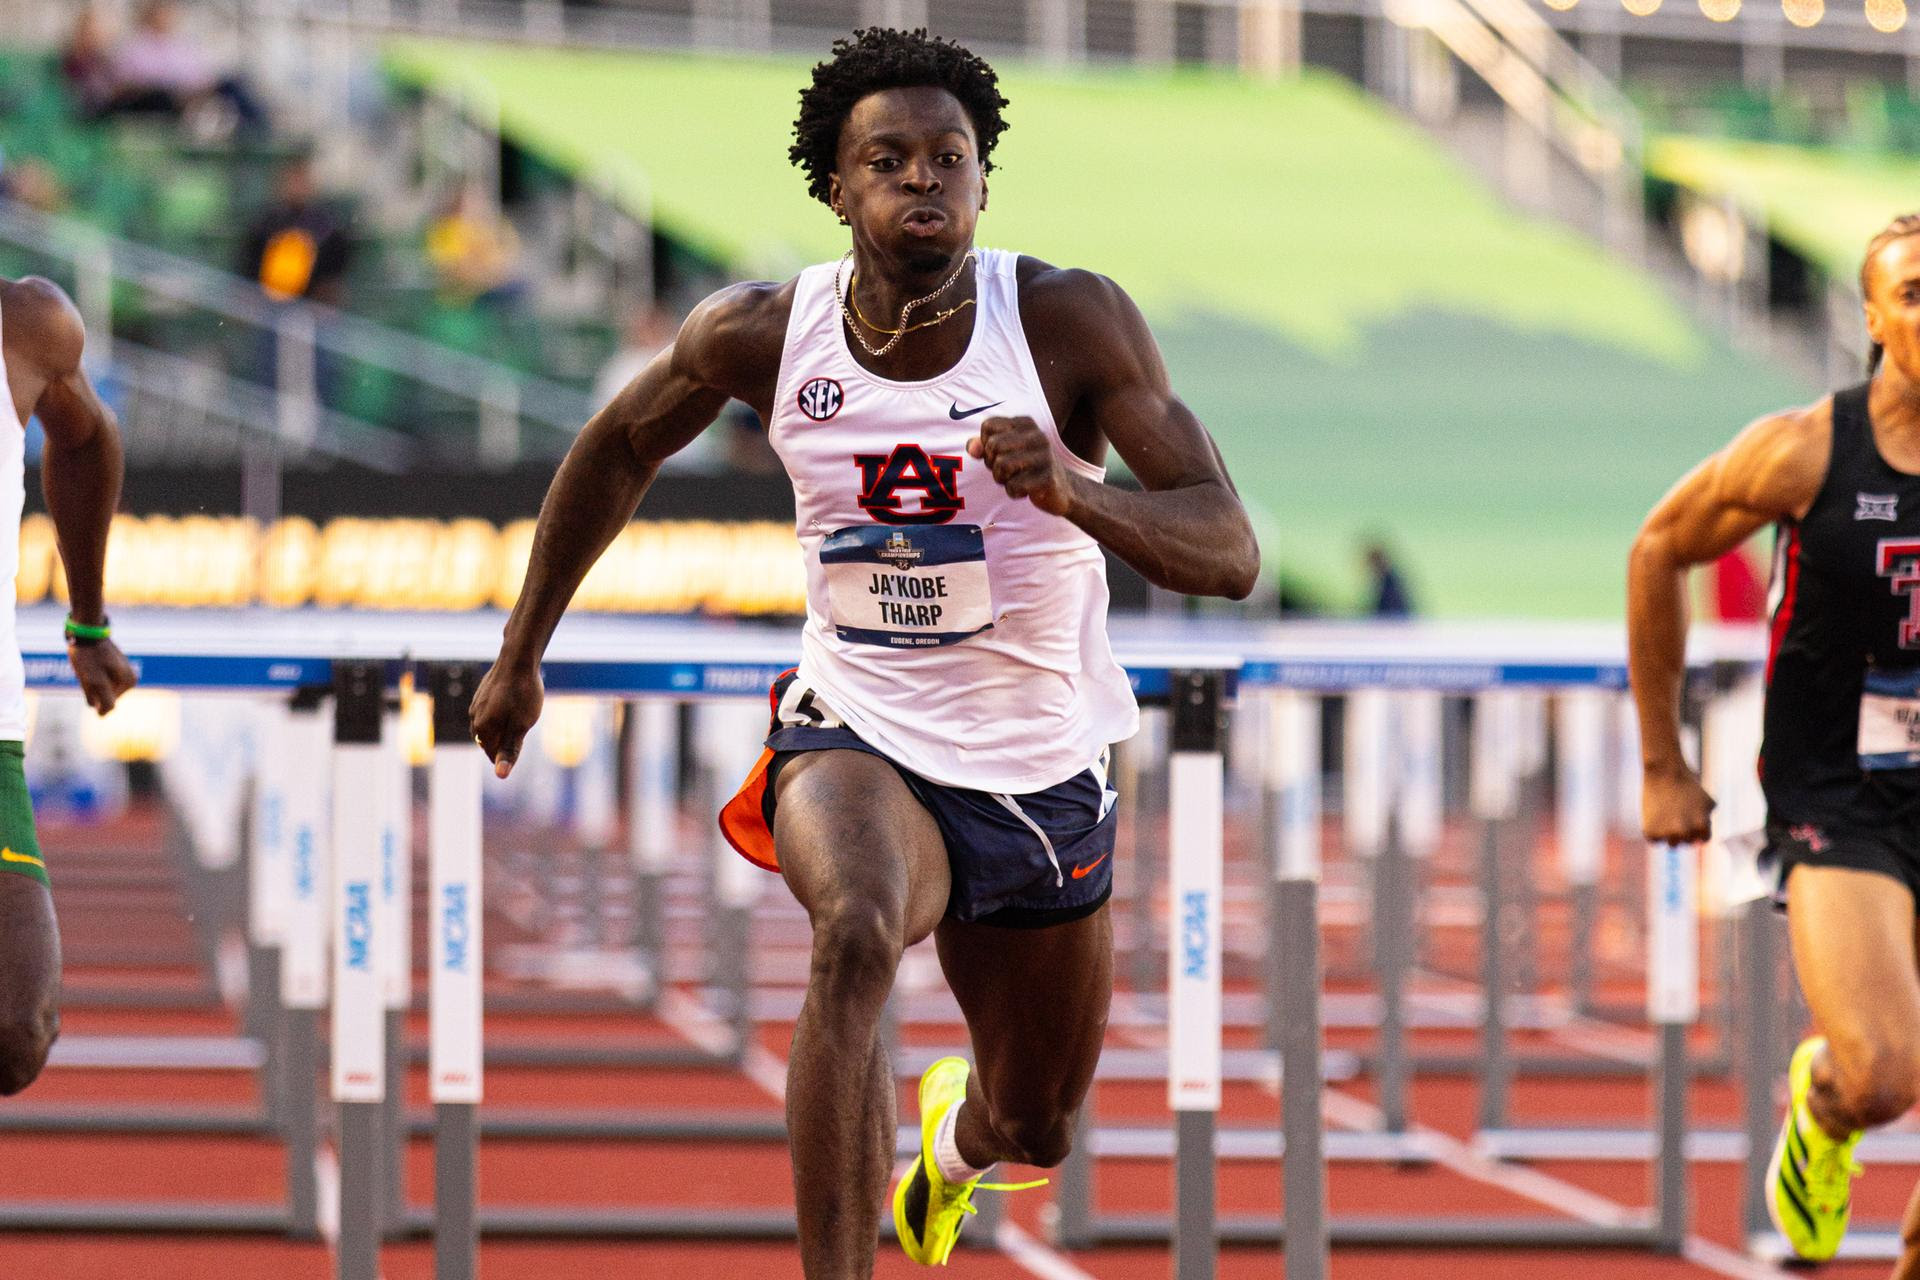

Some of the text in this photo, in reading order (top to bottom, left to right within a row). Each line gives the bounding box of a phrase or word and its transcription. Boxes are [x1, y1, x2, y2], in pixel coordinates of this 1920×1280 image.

[800, 379, 842, 419] SEC
[868, 572, 948, 599] JA'KOBE
[878, 601, 943, 626] THARP
[915, 637, 940, 645] OREGON
